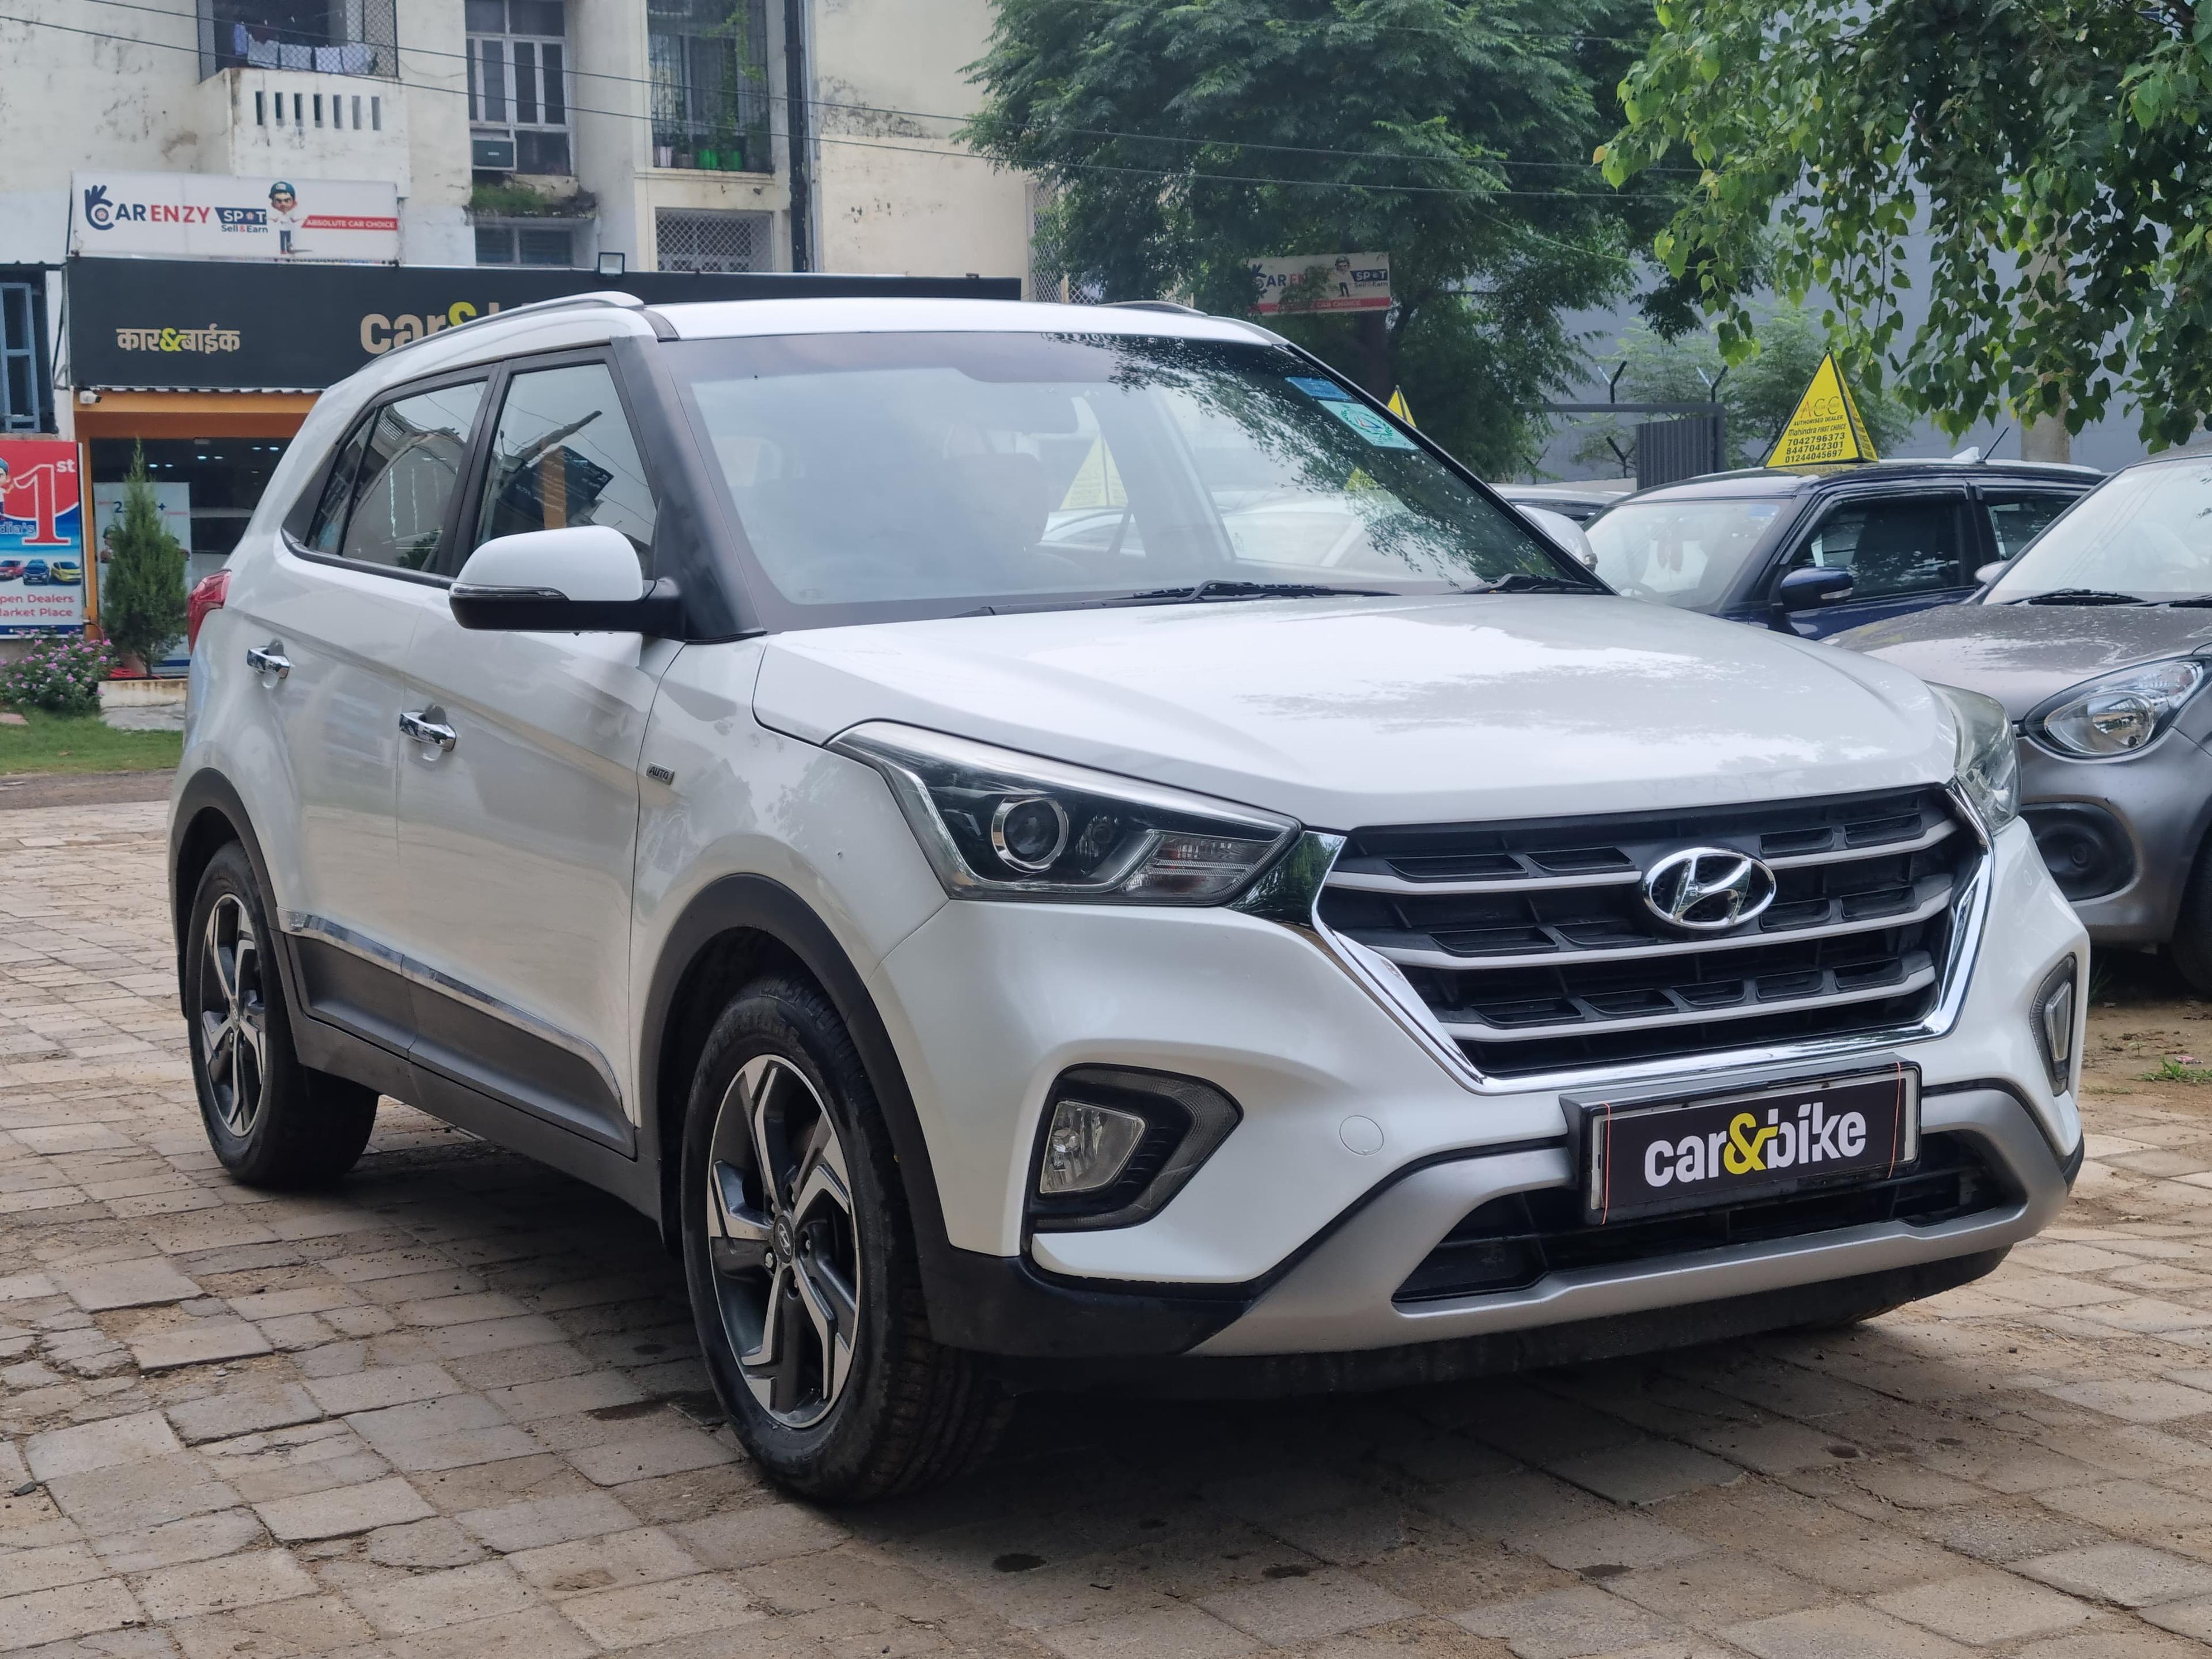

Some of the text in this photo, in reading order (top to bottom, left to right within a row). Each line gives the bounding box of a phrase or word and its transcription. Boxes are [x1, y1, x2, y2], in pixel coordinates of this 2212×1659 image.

[1793, 418, 1824, 426] AUTHORISED
[1788, 427, 1817, 436] Mahindra
[1787, 433, 1845, 446] 7042796373
[1786, 441, 1843, 455] 8447042301
[1785, 449, 1843, 463] 01244045697
[28, 594, 74, 603] Dealers
[0, 608, 73, 616] arket Place
[649, 766, 669, 780] AUTO
[1644, 1101, 1867, 1188] car&bike
